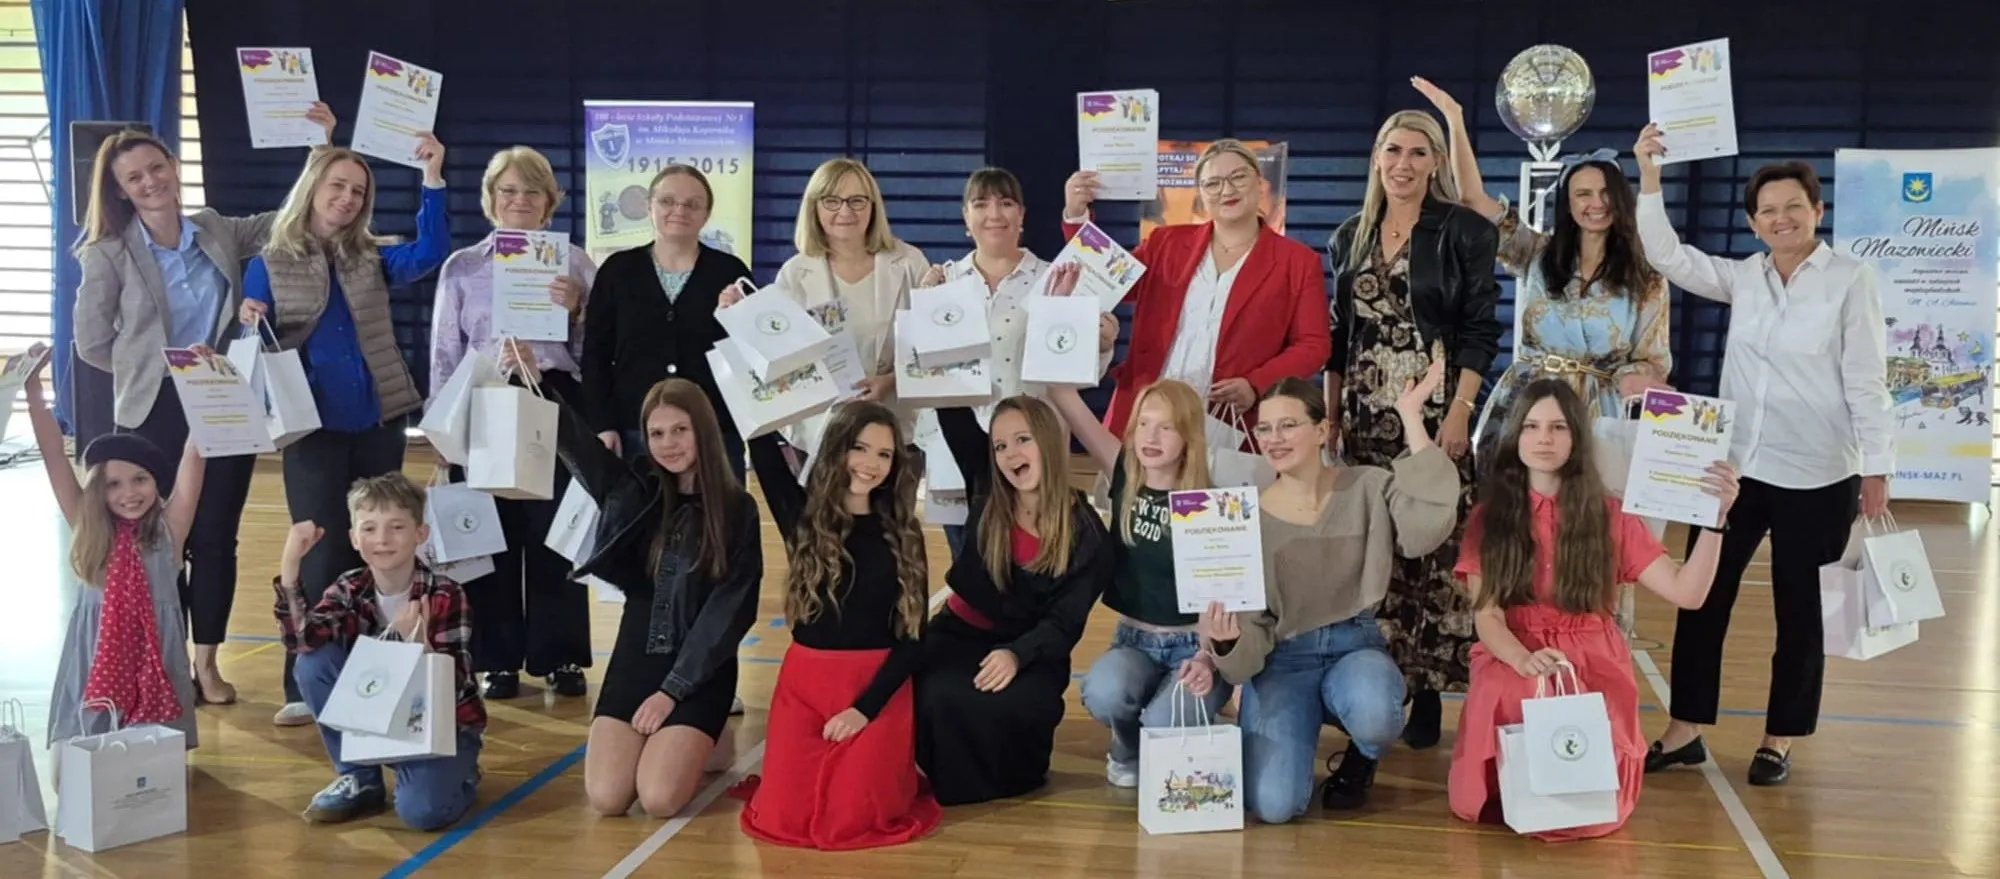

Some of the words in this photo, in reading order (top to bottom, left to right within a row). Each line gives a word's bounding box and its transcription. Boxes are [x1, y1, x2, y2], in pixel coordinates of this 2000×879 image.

[690, 156, 739, 175] 2015
[1903, 216, 1980, 238] Mińsk
[1851, 237, 1974, 258] Mazowiecki
[1133, 518, 1161, 542] 2010
